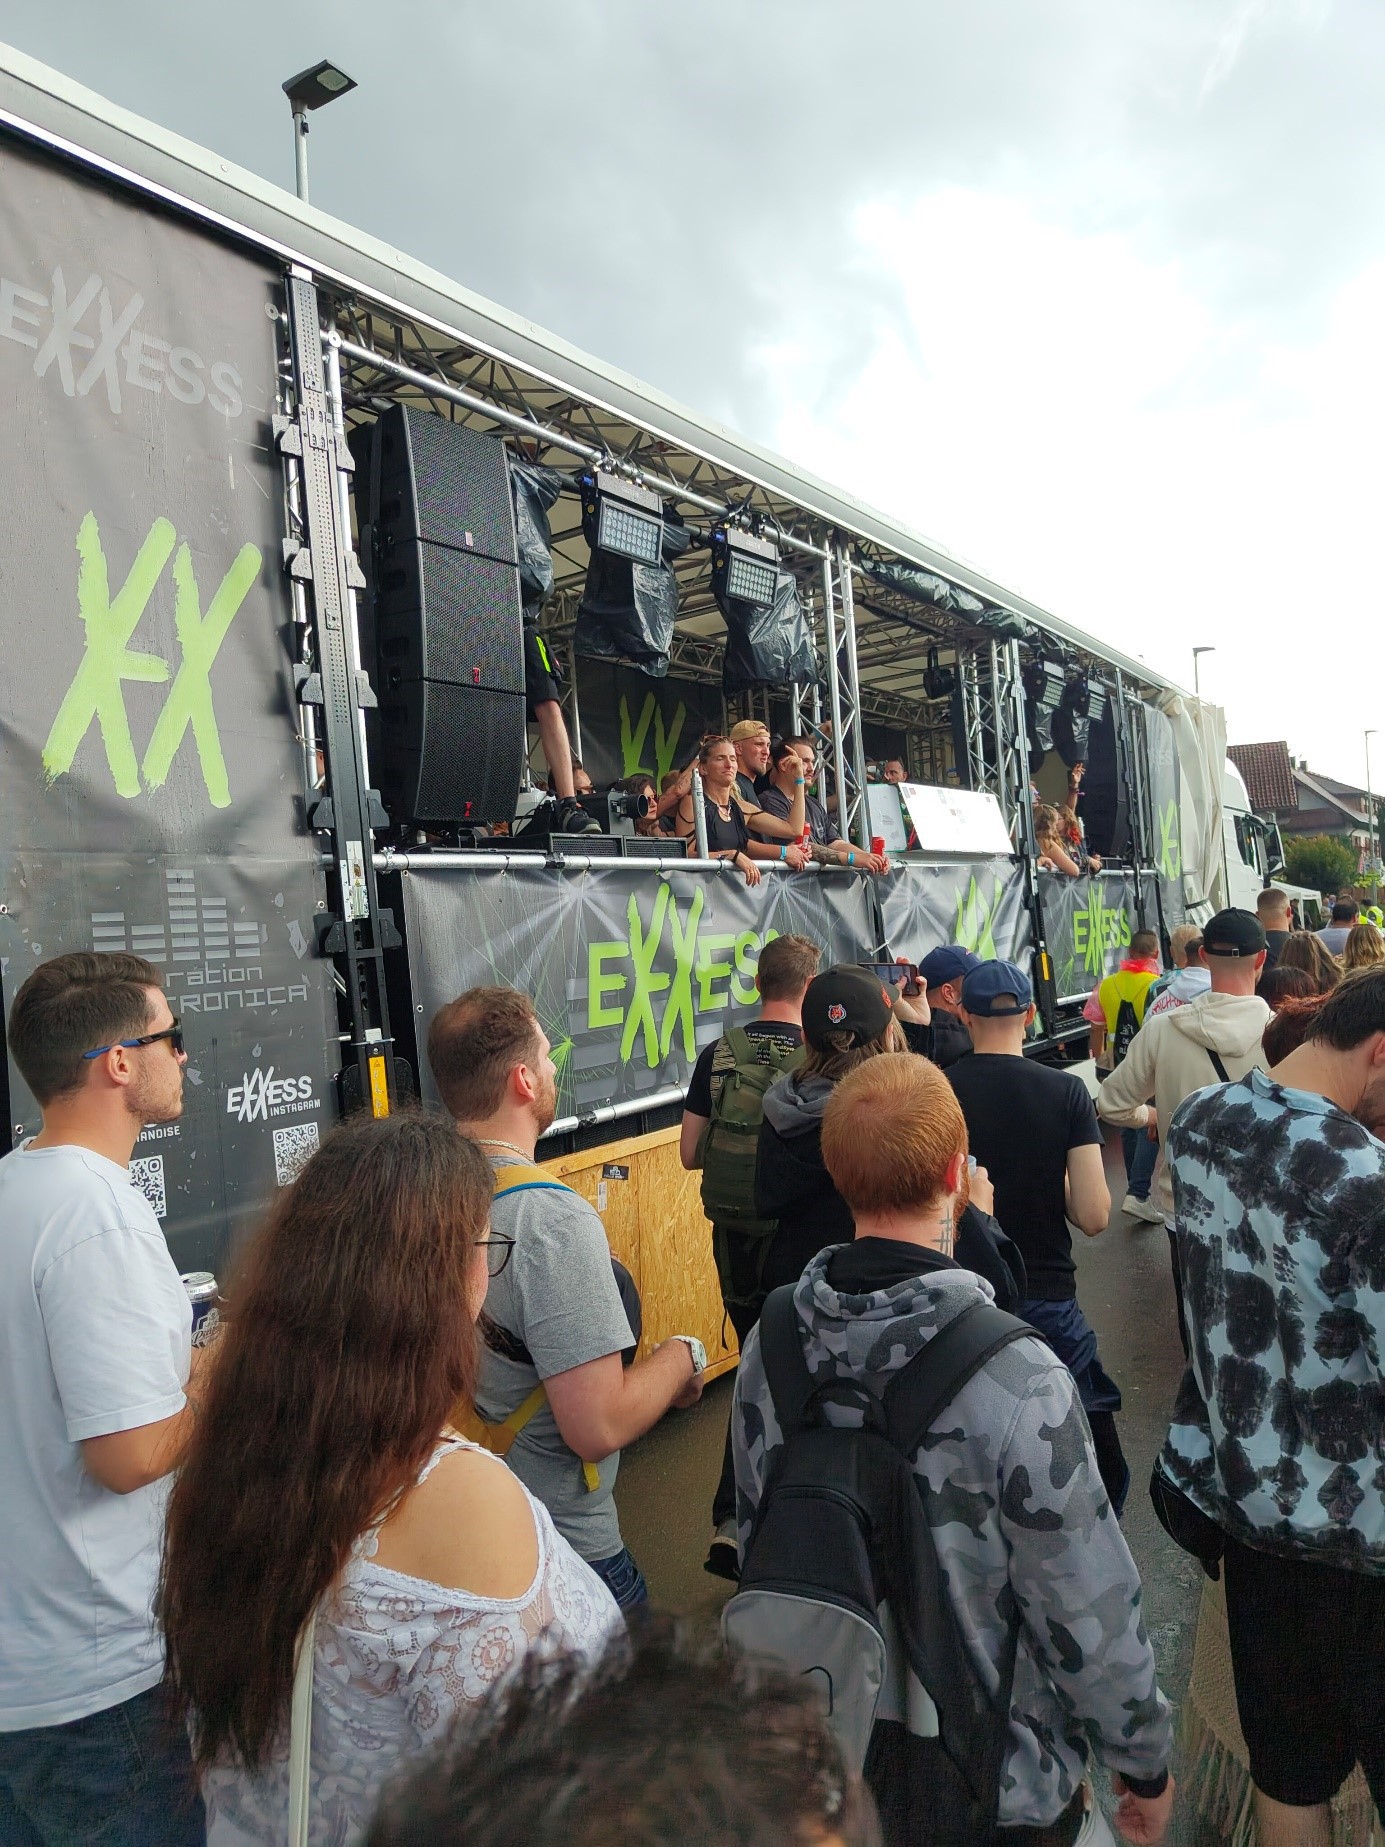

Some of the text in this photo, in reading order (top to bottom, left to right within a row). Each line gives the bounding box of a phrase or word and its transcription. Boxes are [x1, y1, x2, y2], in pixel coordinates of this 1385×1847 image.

[0, 264, 243, 417] EXXESS
[1073, 882, 1132, 977] EXXESS
[165, 961, 263, 988] ration
[588, 882, 780, 1068] EXXES
[166, 984, 308, 1014] RONICA
[226, 1065, 313, 1123] EXXESS
[270, 1098, 321, 1117] INSTAGRAM
[136, 1125, 181, 1143] ANDISE
